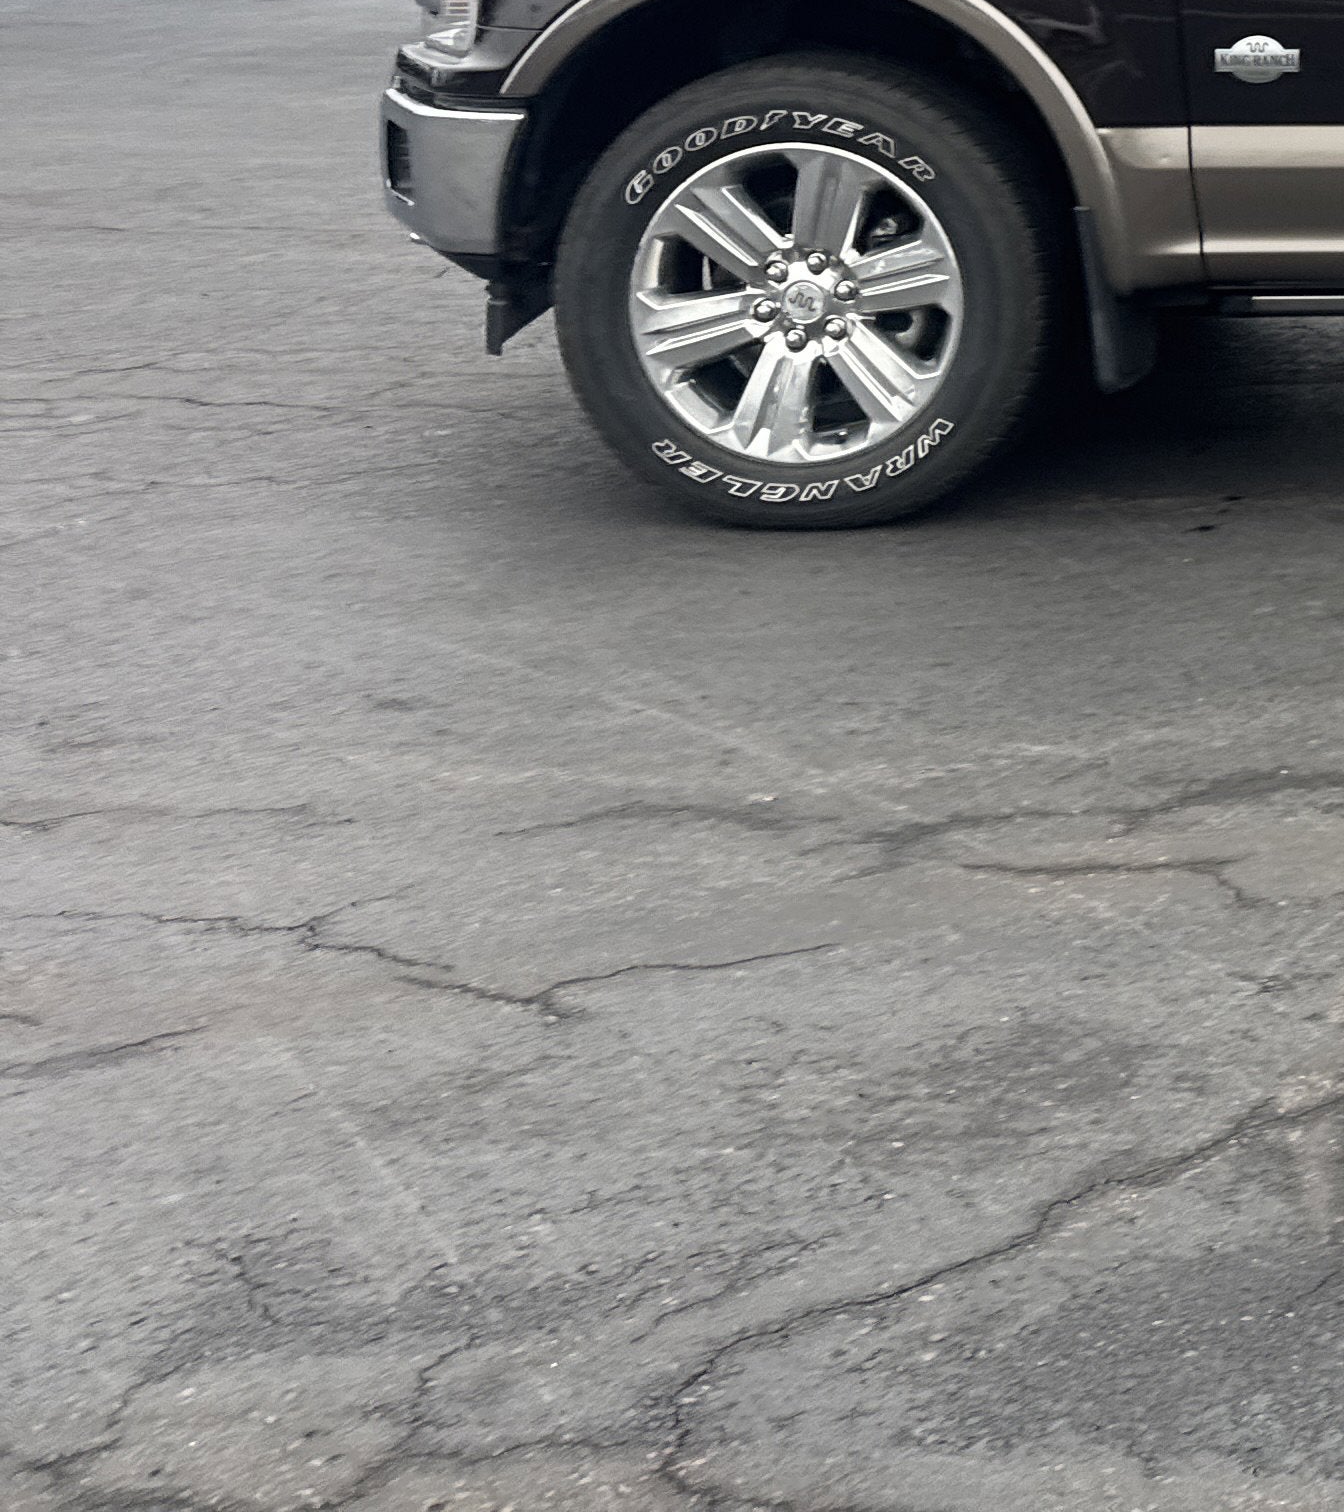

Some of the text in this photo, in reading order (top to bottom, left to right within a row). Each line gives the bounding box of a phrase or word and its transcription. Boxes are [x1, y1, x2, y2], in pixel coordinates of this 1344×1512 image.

[1219, 53, 1297, 67] KING RANCH
[625, 109, 936, 205] GOODYEAR
[651, 418, 954, 503] WRANGLER
